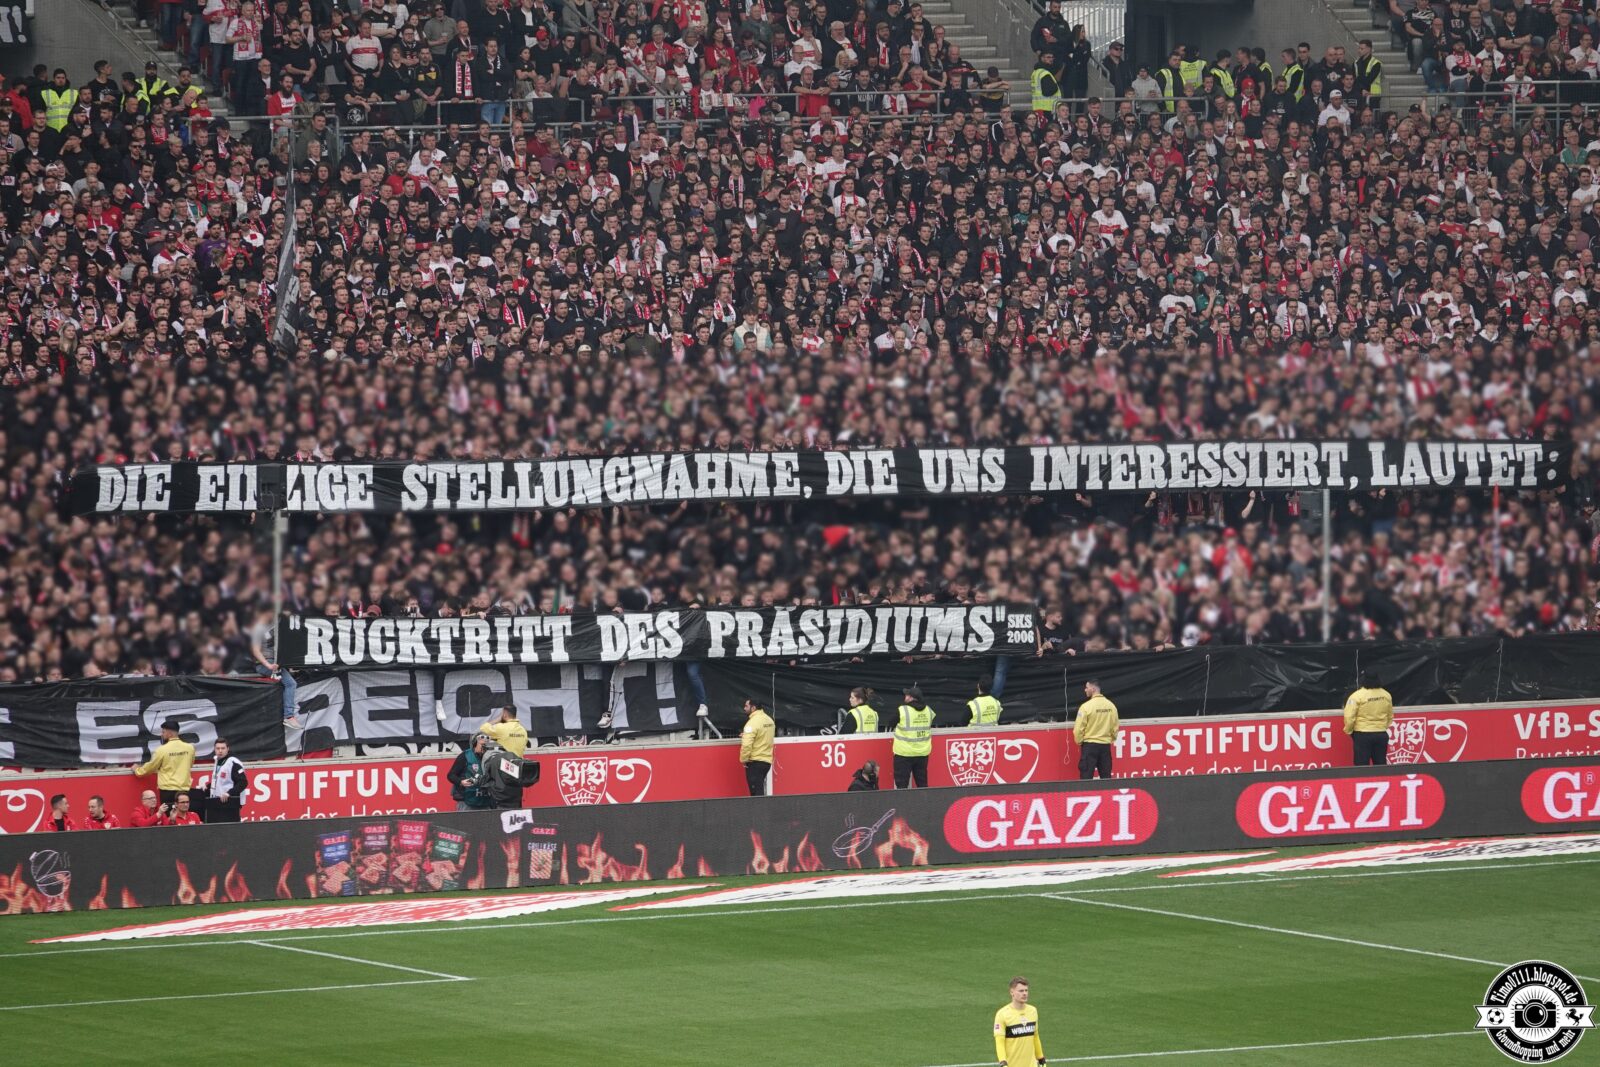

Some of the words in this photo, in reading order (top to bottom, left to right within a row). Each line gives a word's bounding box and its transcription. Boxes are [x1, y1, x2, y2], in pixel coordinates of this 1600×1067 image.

[96, 464, 172, 512] DIE
[401, 452, 812, 512] STELLUNGNAHME,
[824, 450, 899, 496] DIE
[918, 448, 1006, 494] UNS
[1029, 442, 1358, 491] INTERESSIERT,
[1368, 442, 1559, 487] LAUTET:
[596, 611, 683, 662] DES
[1007, 613, 1033, 629] SKS
[1007, 630, 1034, 643] 2006
[76, 698, 218, 764] ES
[1114, 721, 1332, 758] fB-STIFTUNG
[820, 743, 846, 768] 36
